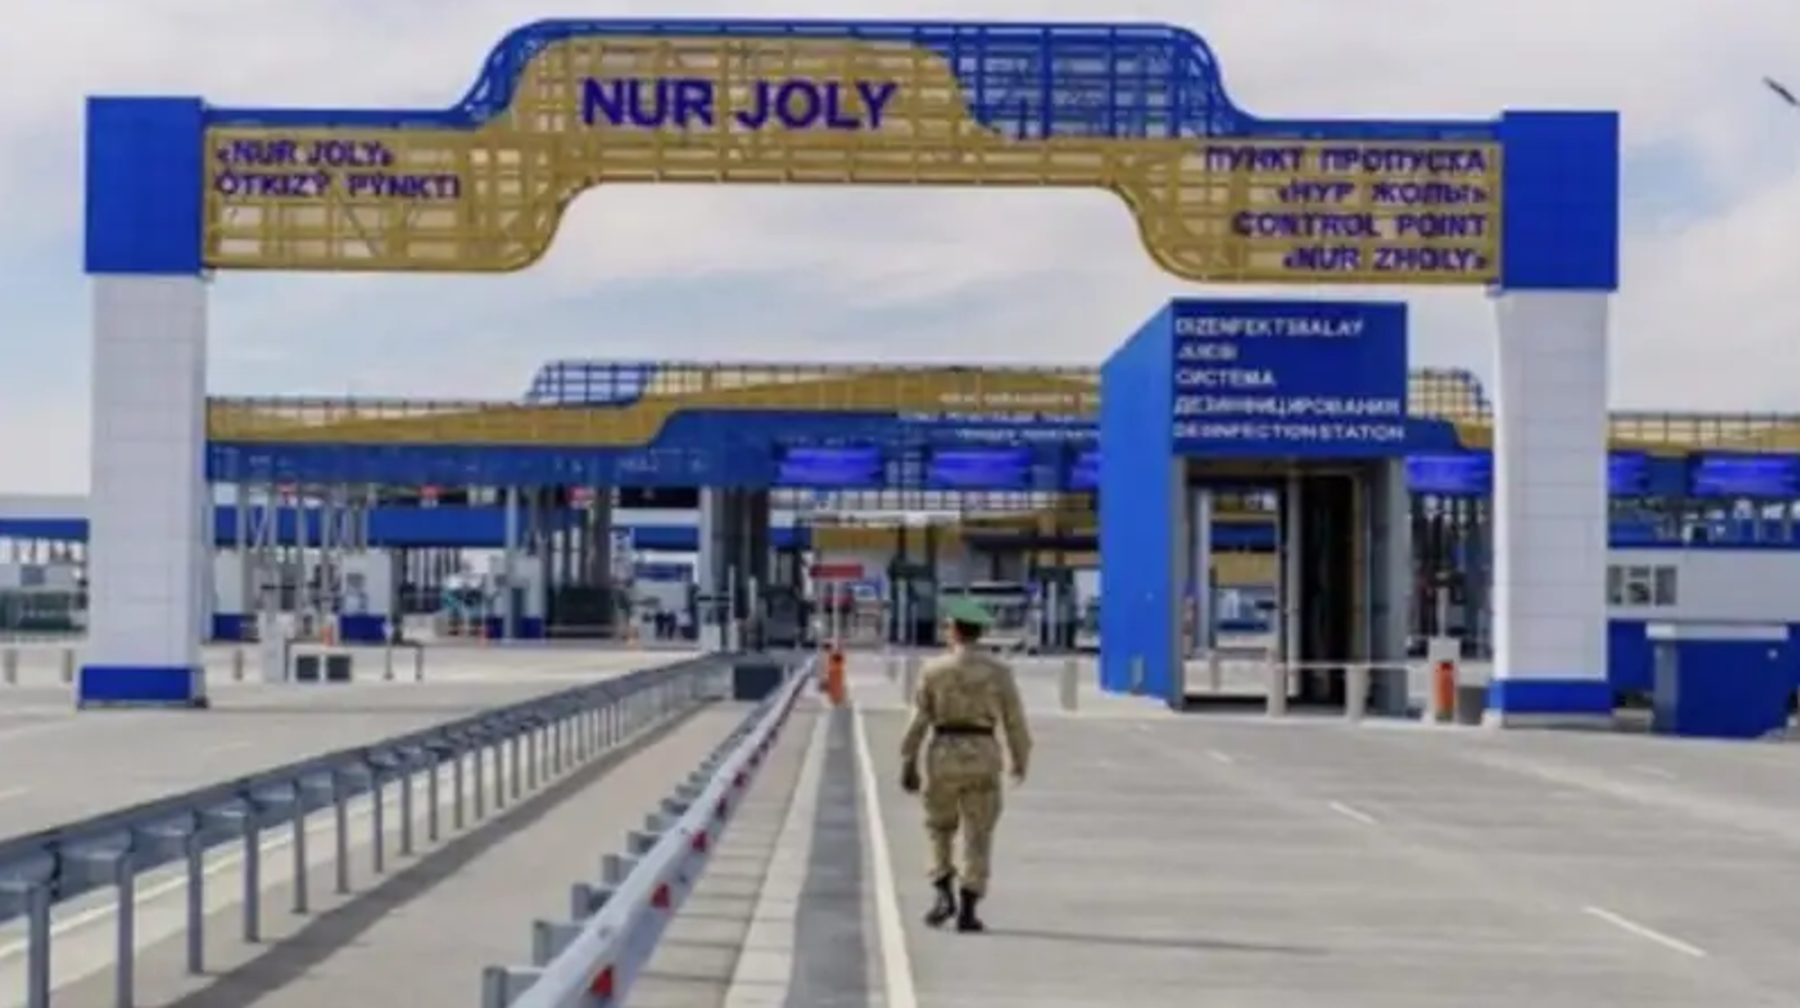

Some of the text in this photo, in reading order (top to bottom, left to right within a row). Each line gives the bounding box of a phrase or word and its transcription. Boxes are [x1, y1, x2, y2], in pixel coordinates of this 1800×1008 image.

[582, 76, 896, 129] NUR JOLY
[1205, 147, 1486, 172] ПУНКТ ПРОПУСКА
[1233, 212, 1486, 237] CONTROL POINT
[1175, 369, 1277, 388] СИСТЕМА
[1319, 423, 1405, 443] STATION
